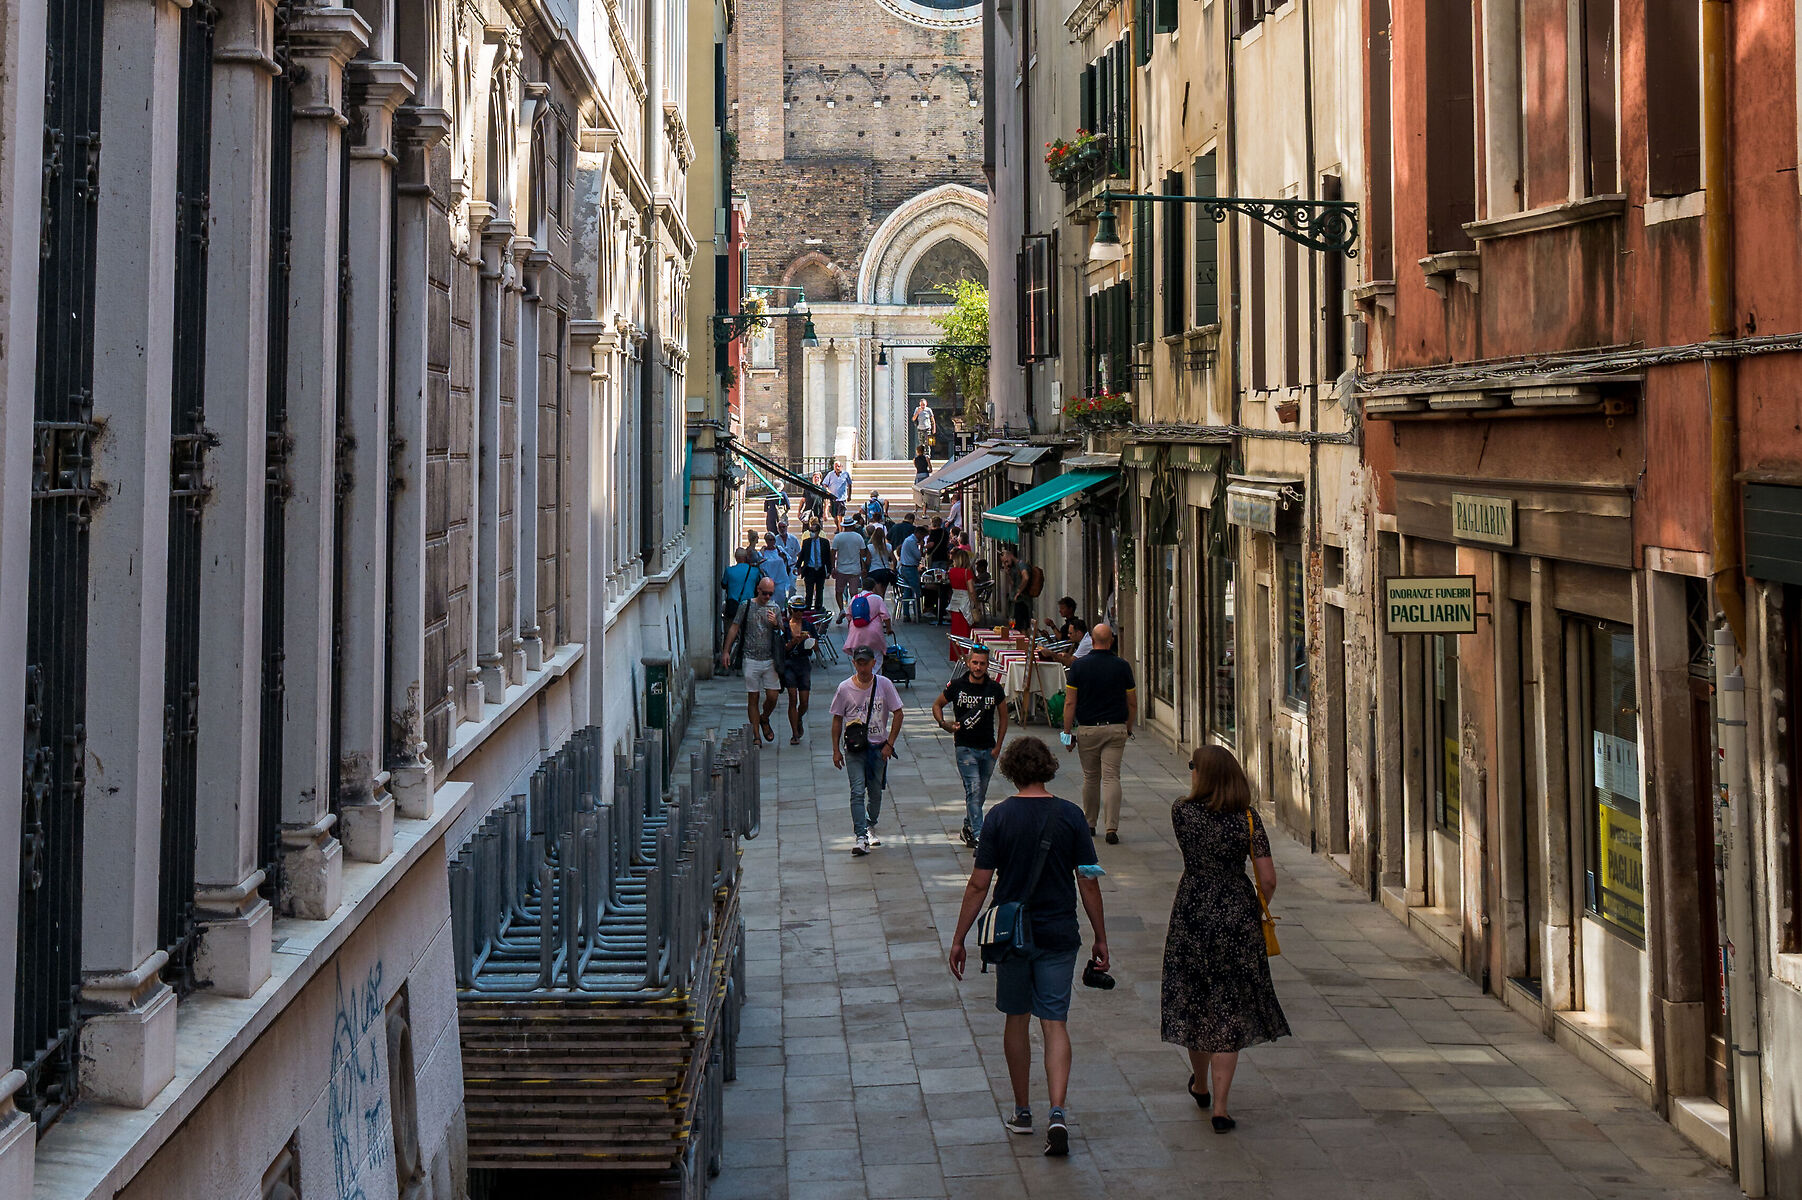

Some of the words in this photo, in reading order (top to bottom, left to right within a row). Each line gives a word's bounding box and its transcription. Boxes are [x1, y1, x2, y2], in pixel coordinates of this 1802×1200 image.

[956, 432, 972, 452] T
[1456, 501, 1507, 537] PAGLIARIN
[1389, 588, 1434, 599] ONORANZE
[1435, 587, 1471, 598] FUNEBRI
[1390, 604, 1471, 623] PAGLIARIN
